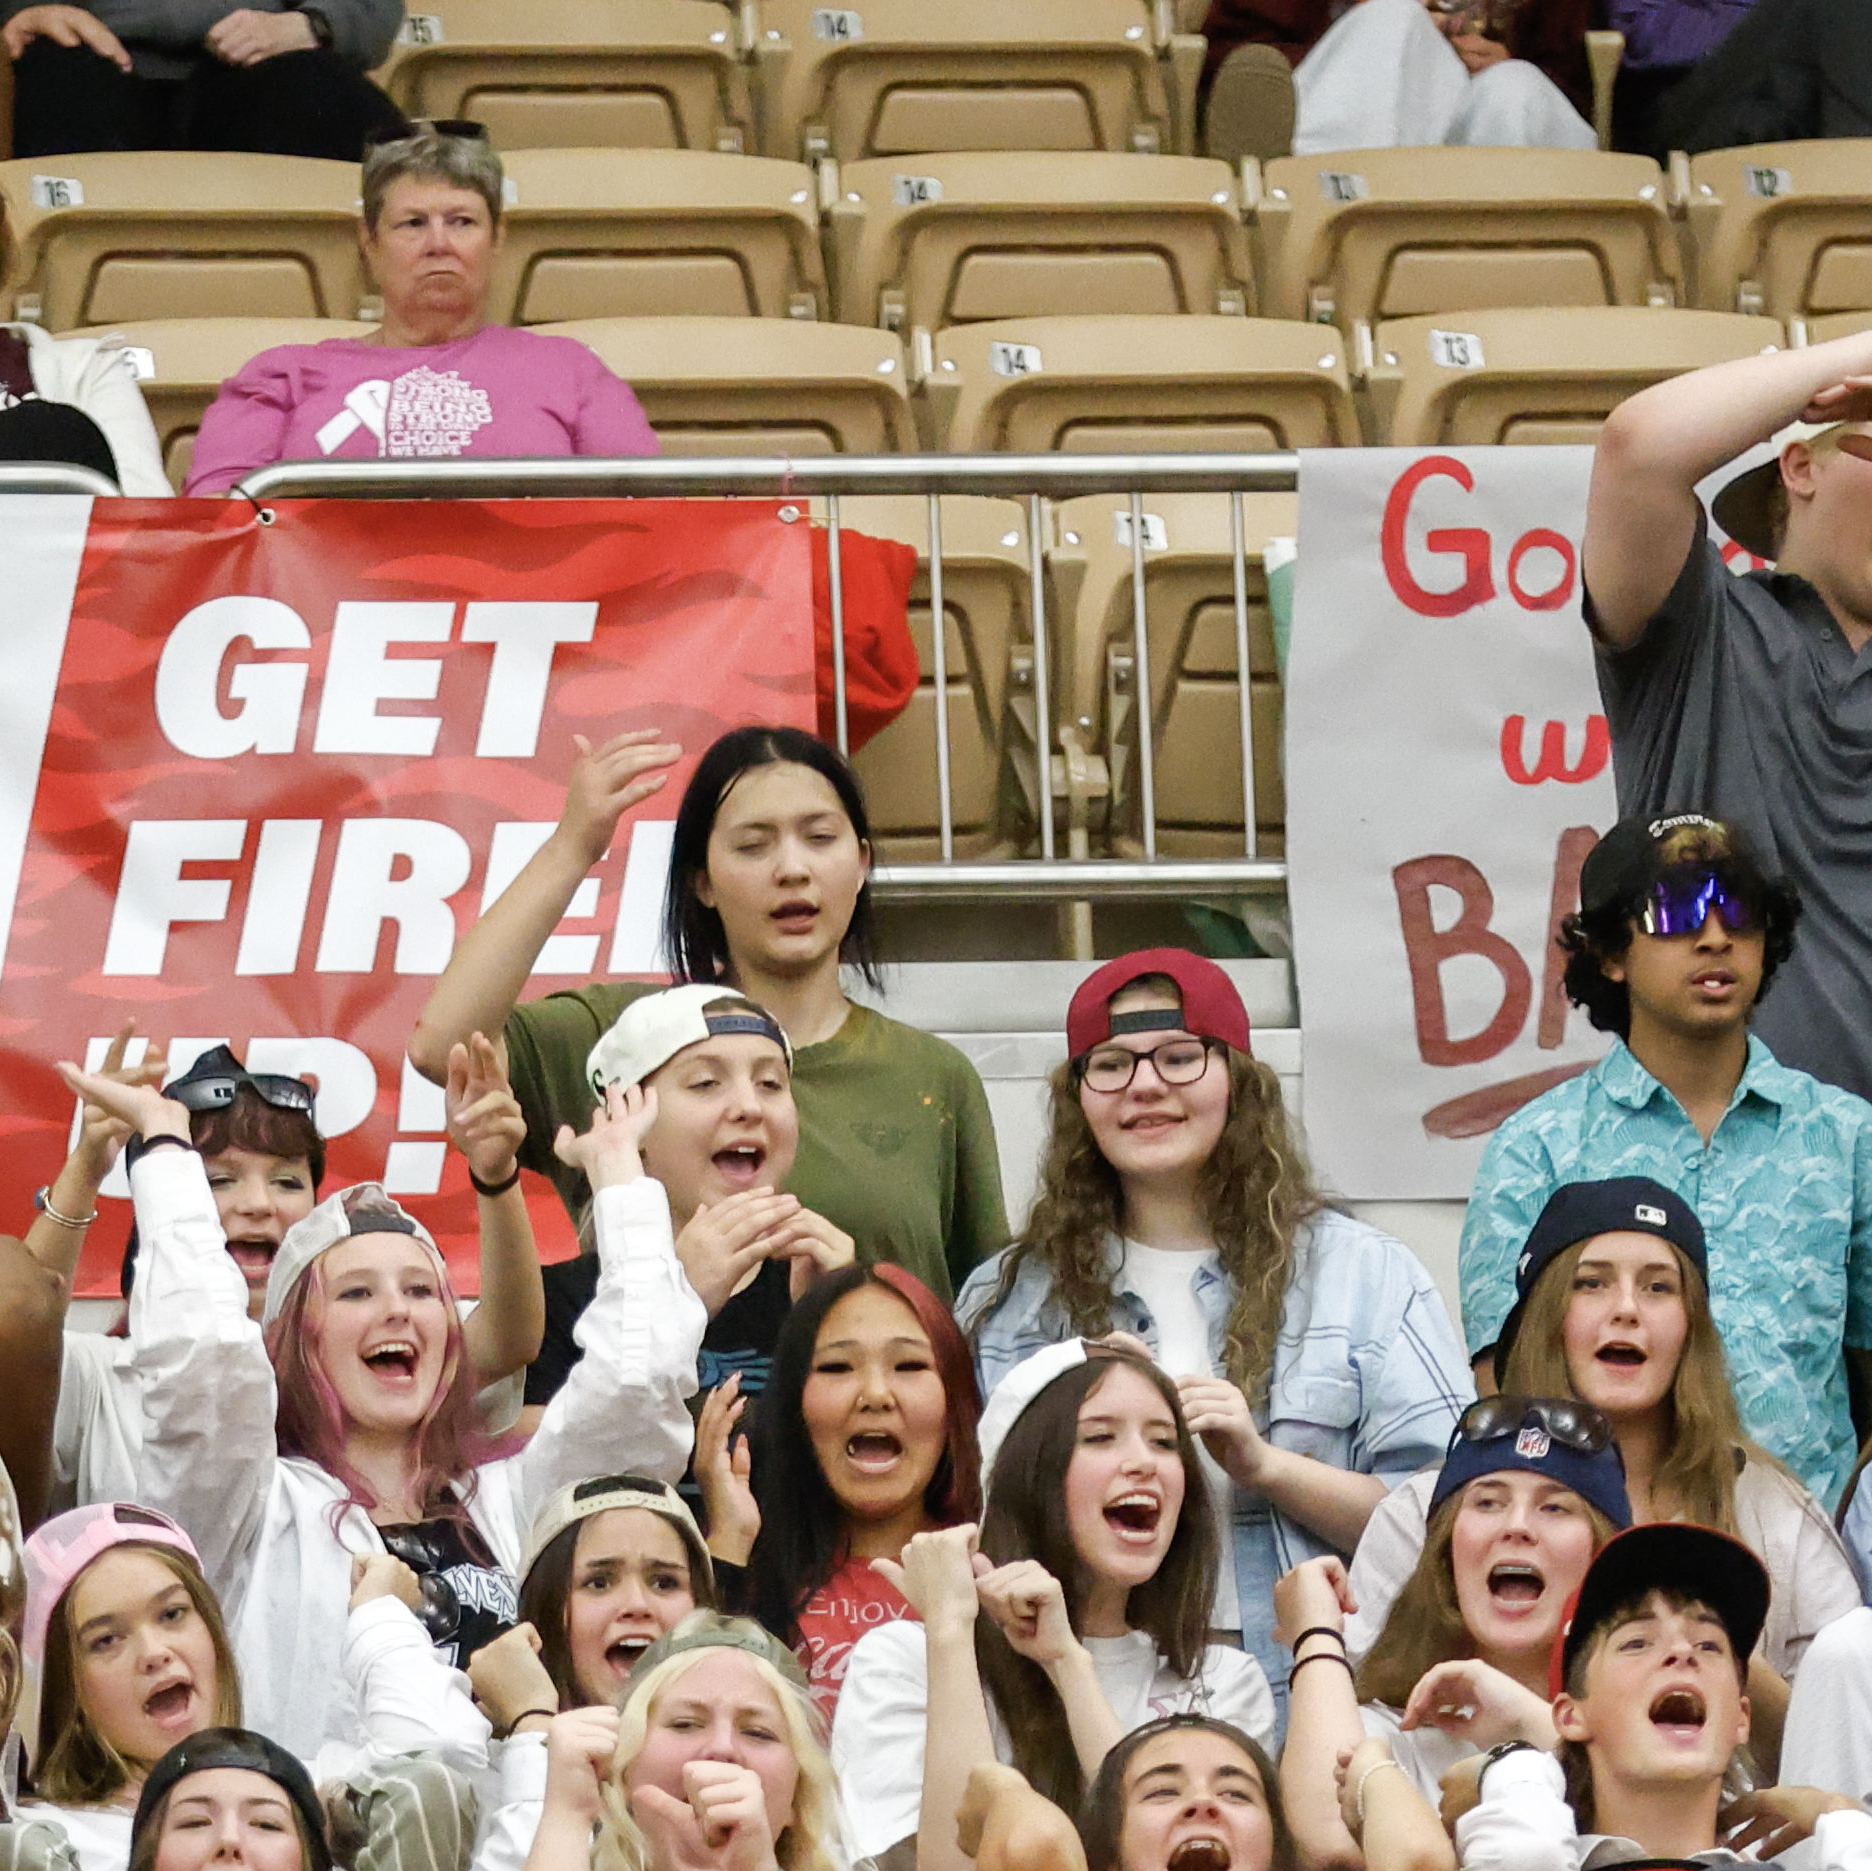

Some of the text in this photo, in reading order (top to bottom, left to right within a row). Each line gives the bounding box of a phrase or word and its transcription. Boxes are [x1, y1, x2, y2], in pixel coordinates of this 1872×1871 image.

[1001, 347, 1027, 373] 14
[1443, 337, 1470, 366] 13
[389, 430, 474, 446] CHOICE
[153, 595, 600, 760] GET
[101, 819, 678, 977] FIRE
